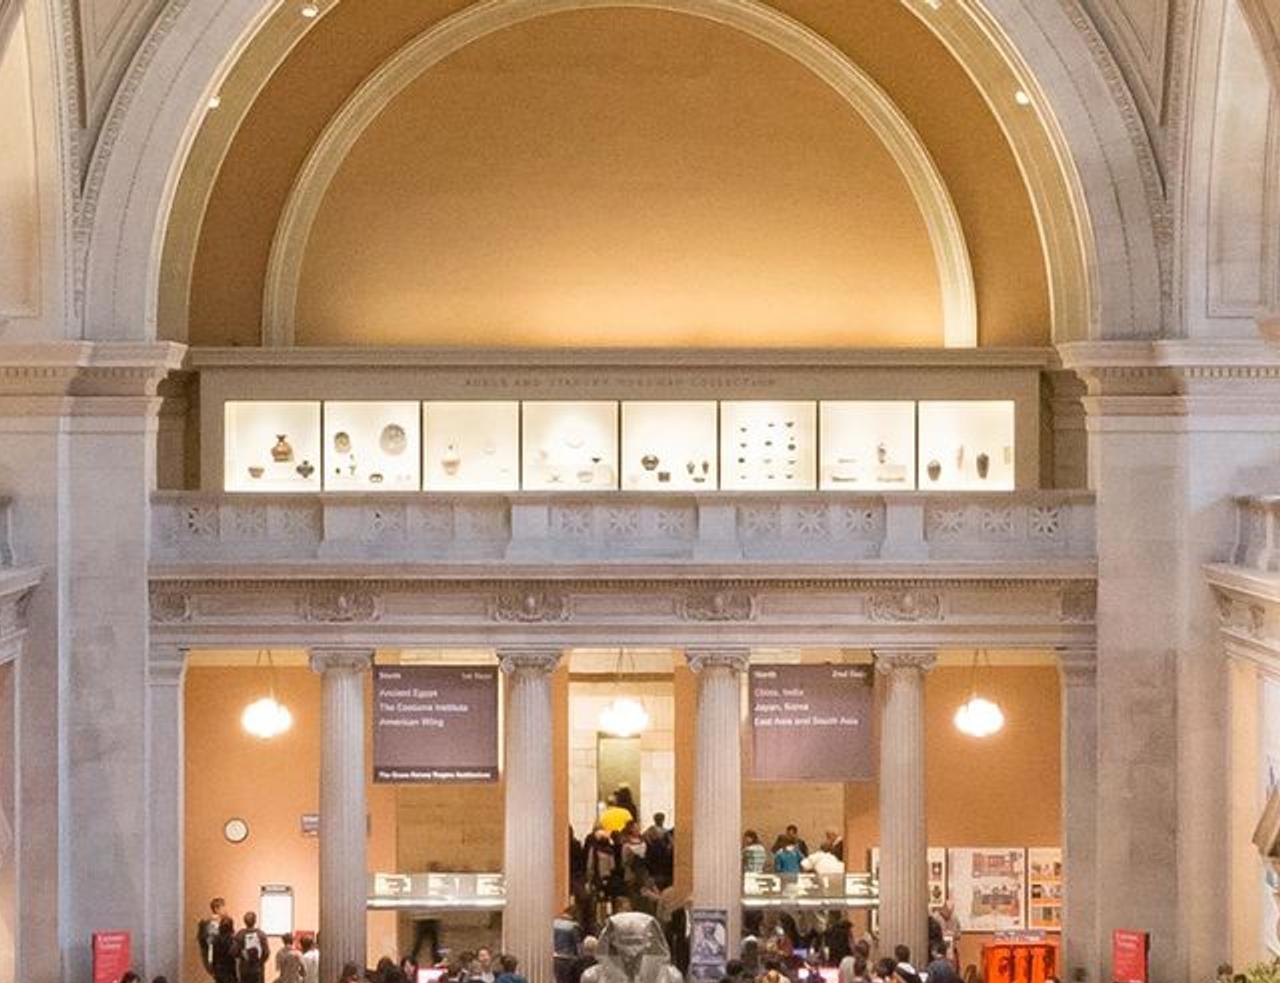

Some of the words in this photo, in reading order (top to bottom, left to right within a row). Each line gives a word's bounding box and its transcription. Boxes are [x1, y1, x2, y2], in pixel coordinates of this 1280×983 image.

[413, 690, 437, 698] Egypt
[782, 688, 804, 697] India
[380, 703, 395, 711] The
[397, 703, 433, 711] Costume
[783, 702, 809, 711] Korea
[422, 719, 444, 727] Wing
[754, 717, 772, 726] East
[773, 717, 793, 726] Asia
[794, 717, 811, 726] and
[813, 717, 838, 725] South
[840, 717, 859, 725] Asia
